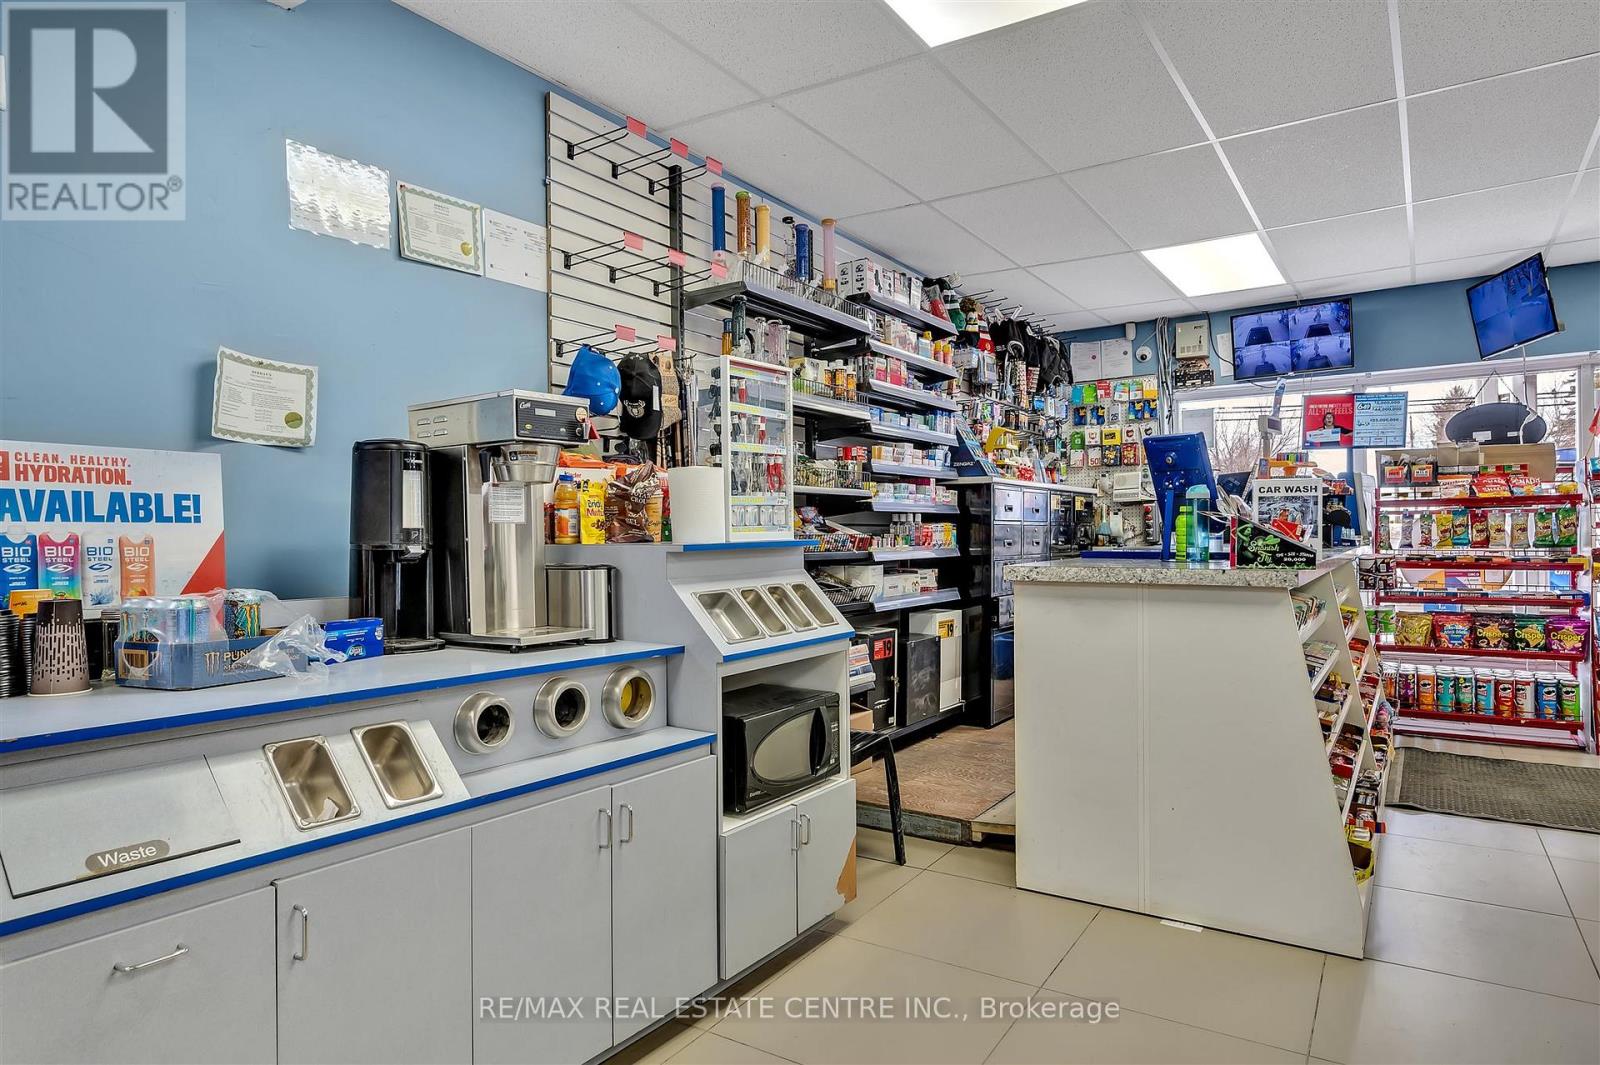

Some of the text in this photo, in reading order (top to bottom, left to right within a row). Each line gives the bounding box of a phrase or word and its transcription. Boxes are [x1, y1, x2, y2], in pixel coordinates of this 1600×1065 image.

[14, 452, 131, 467] CLEAN. HEALTHY.
[15, 464, 132, 485] HYDRATION.
[1259, 485, 1318, 494] CAR WASH
[0, 488, 201, 523] AVAILABLE!
[1, 547, 31, 556] BIO
[44, 546, 74, 556] BIO
[87, 547, 113, 556] BIO
[124, 547, 149, 556] BIO
[1550, 632, 1585, 641] Crispers
[97, 846, 157, 867] Waste
